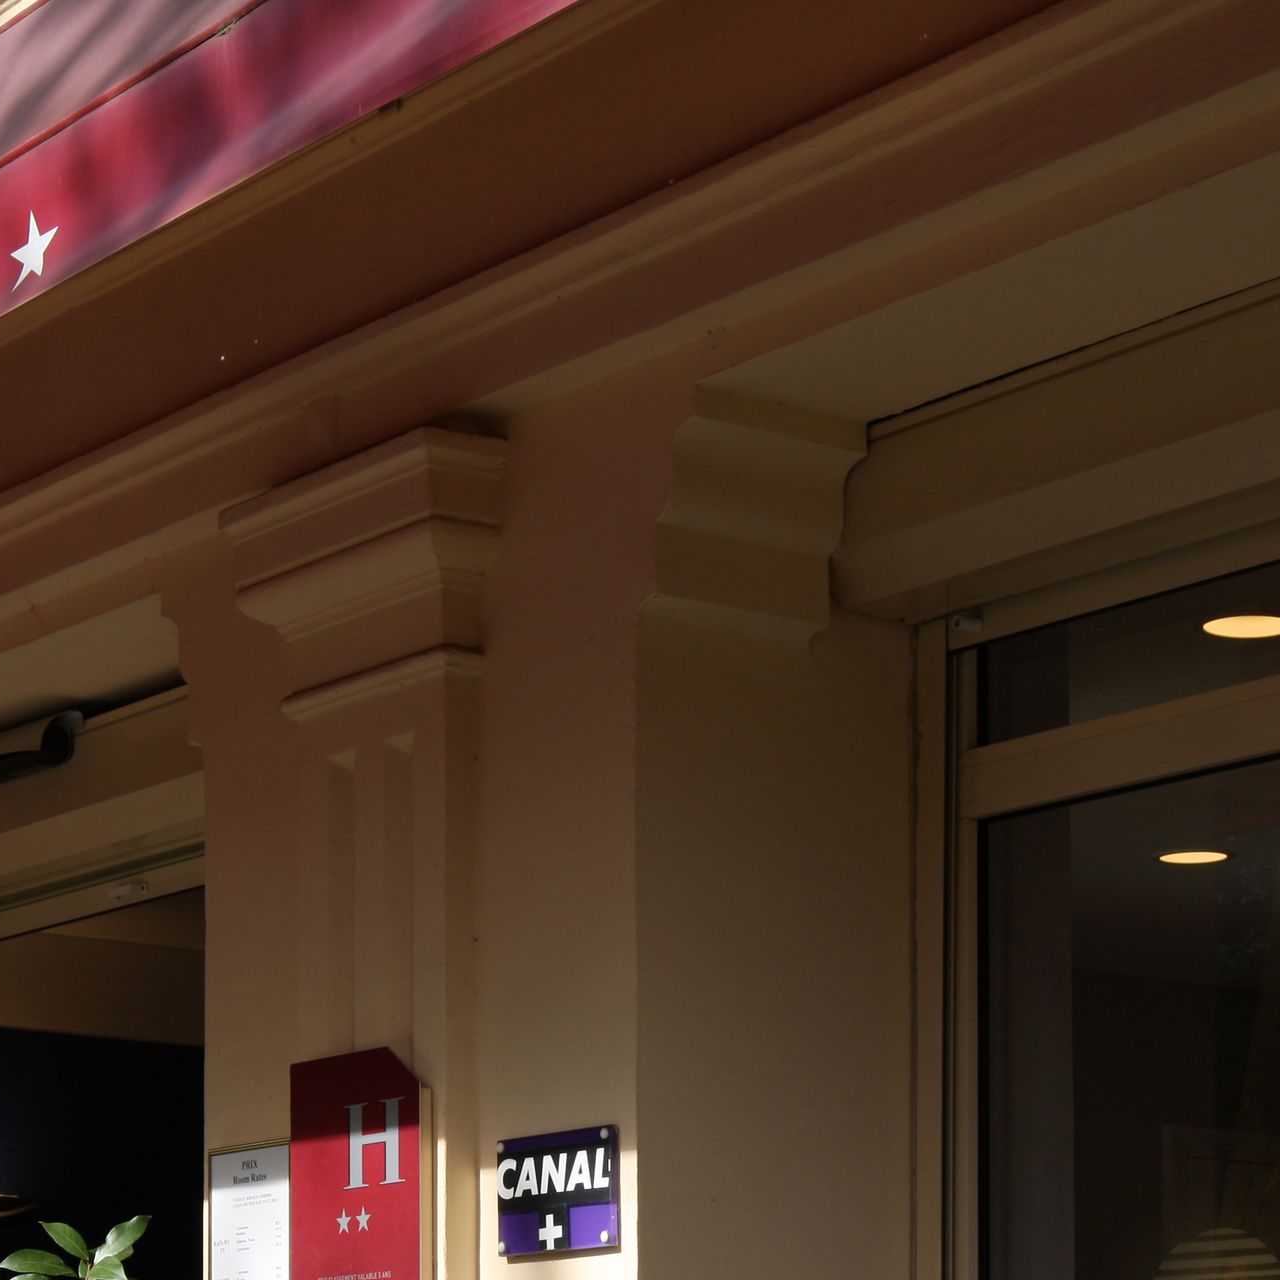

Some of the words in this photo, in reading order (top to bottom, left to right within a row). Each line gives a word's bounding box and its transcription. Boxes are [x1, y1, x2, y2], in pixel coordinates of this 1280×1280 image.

[344, 1097, 406, 1190] H
[241, 1159, 258, 1171] PRIX
[497, 1147, 610, 1200] CANAL
[357, 1271, 377, 1280] VALABLE
